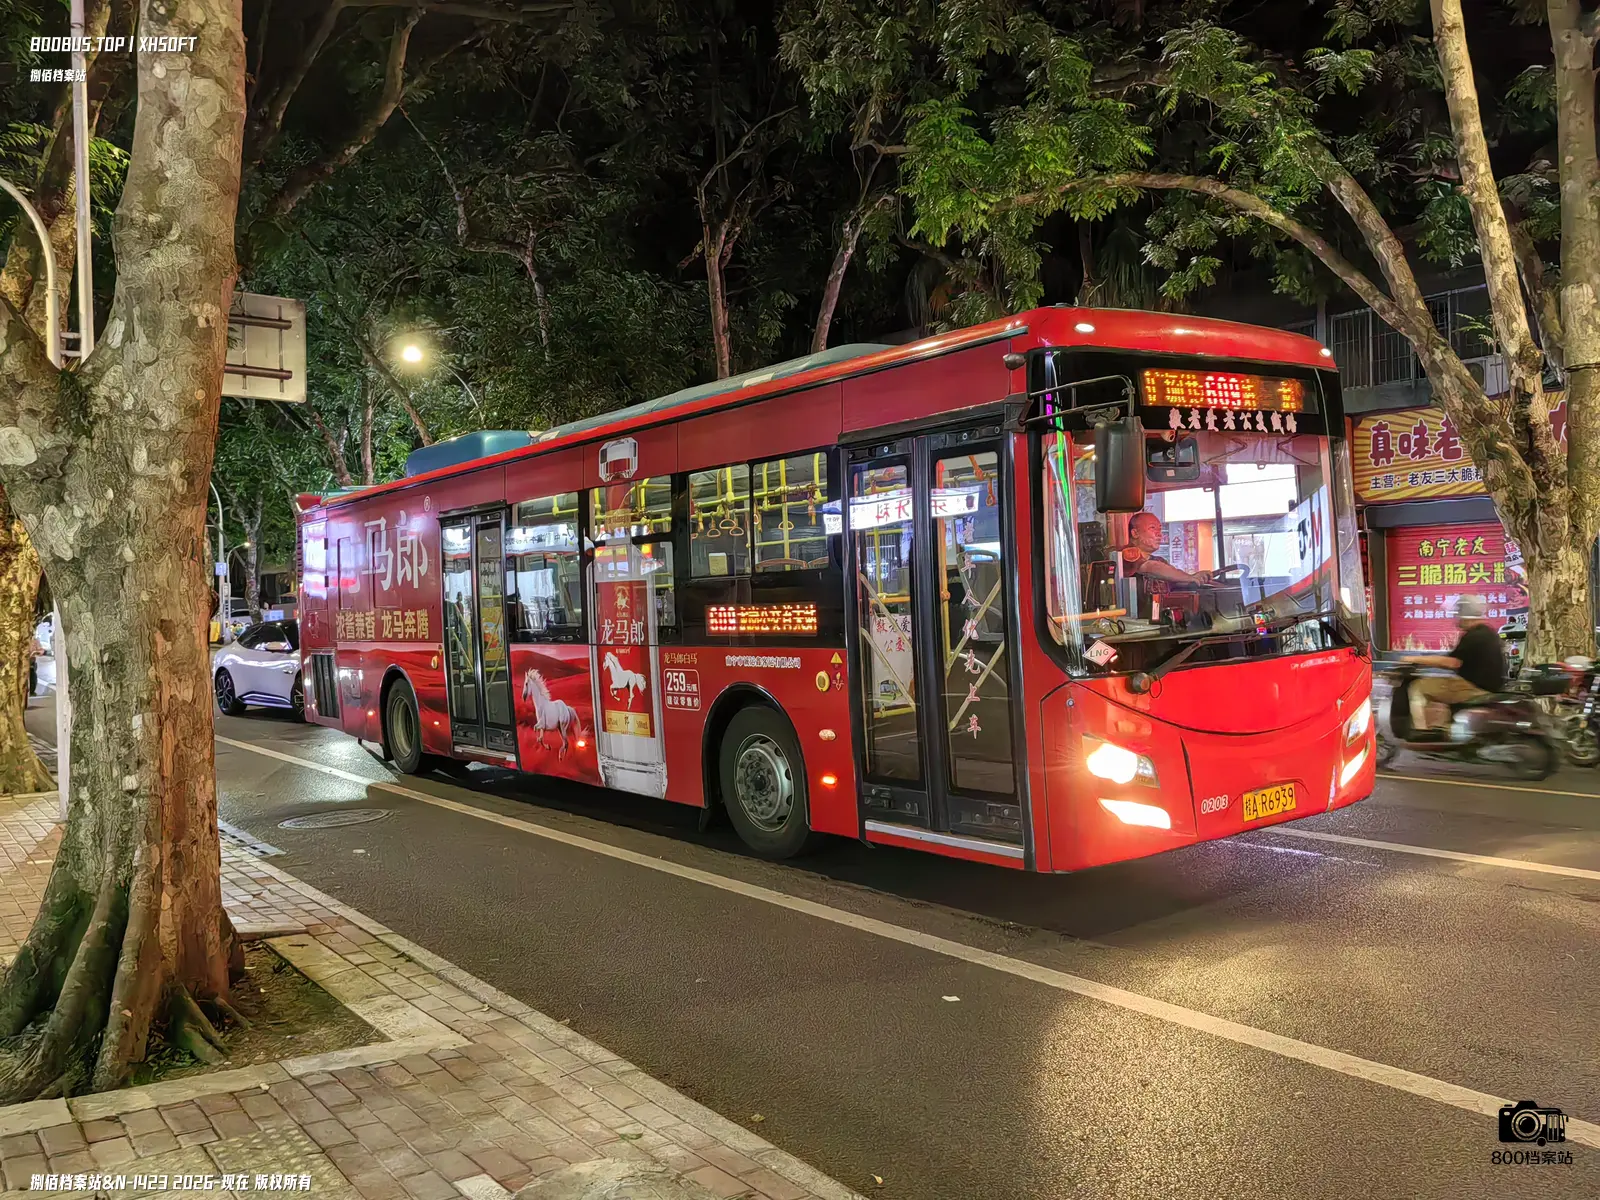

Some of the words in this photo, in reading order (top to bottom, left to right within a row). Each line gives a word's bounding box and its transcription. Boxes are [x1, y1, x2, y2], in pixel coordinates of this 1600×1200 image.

[1418, 536, 1489, 558] 南宁老友
[381, 608, 430, 640] 龙马奔腾
[600, 618, 645, 645] 龙马郎
[663, 653, 698, 665] 龙马郎白马
[1090, 648, 1109, 658] LNG
[1201, 794, 1229, 815] 0203
